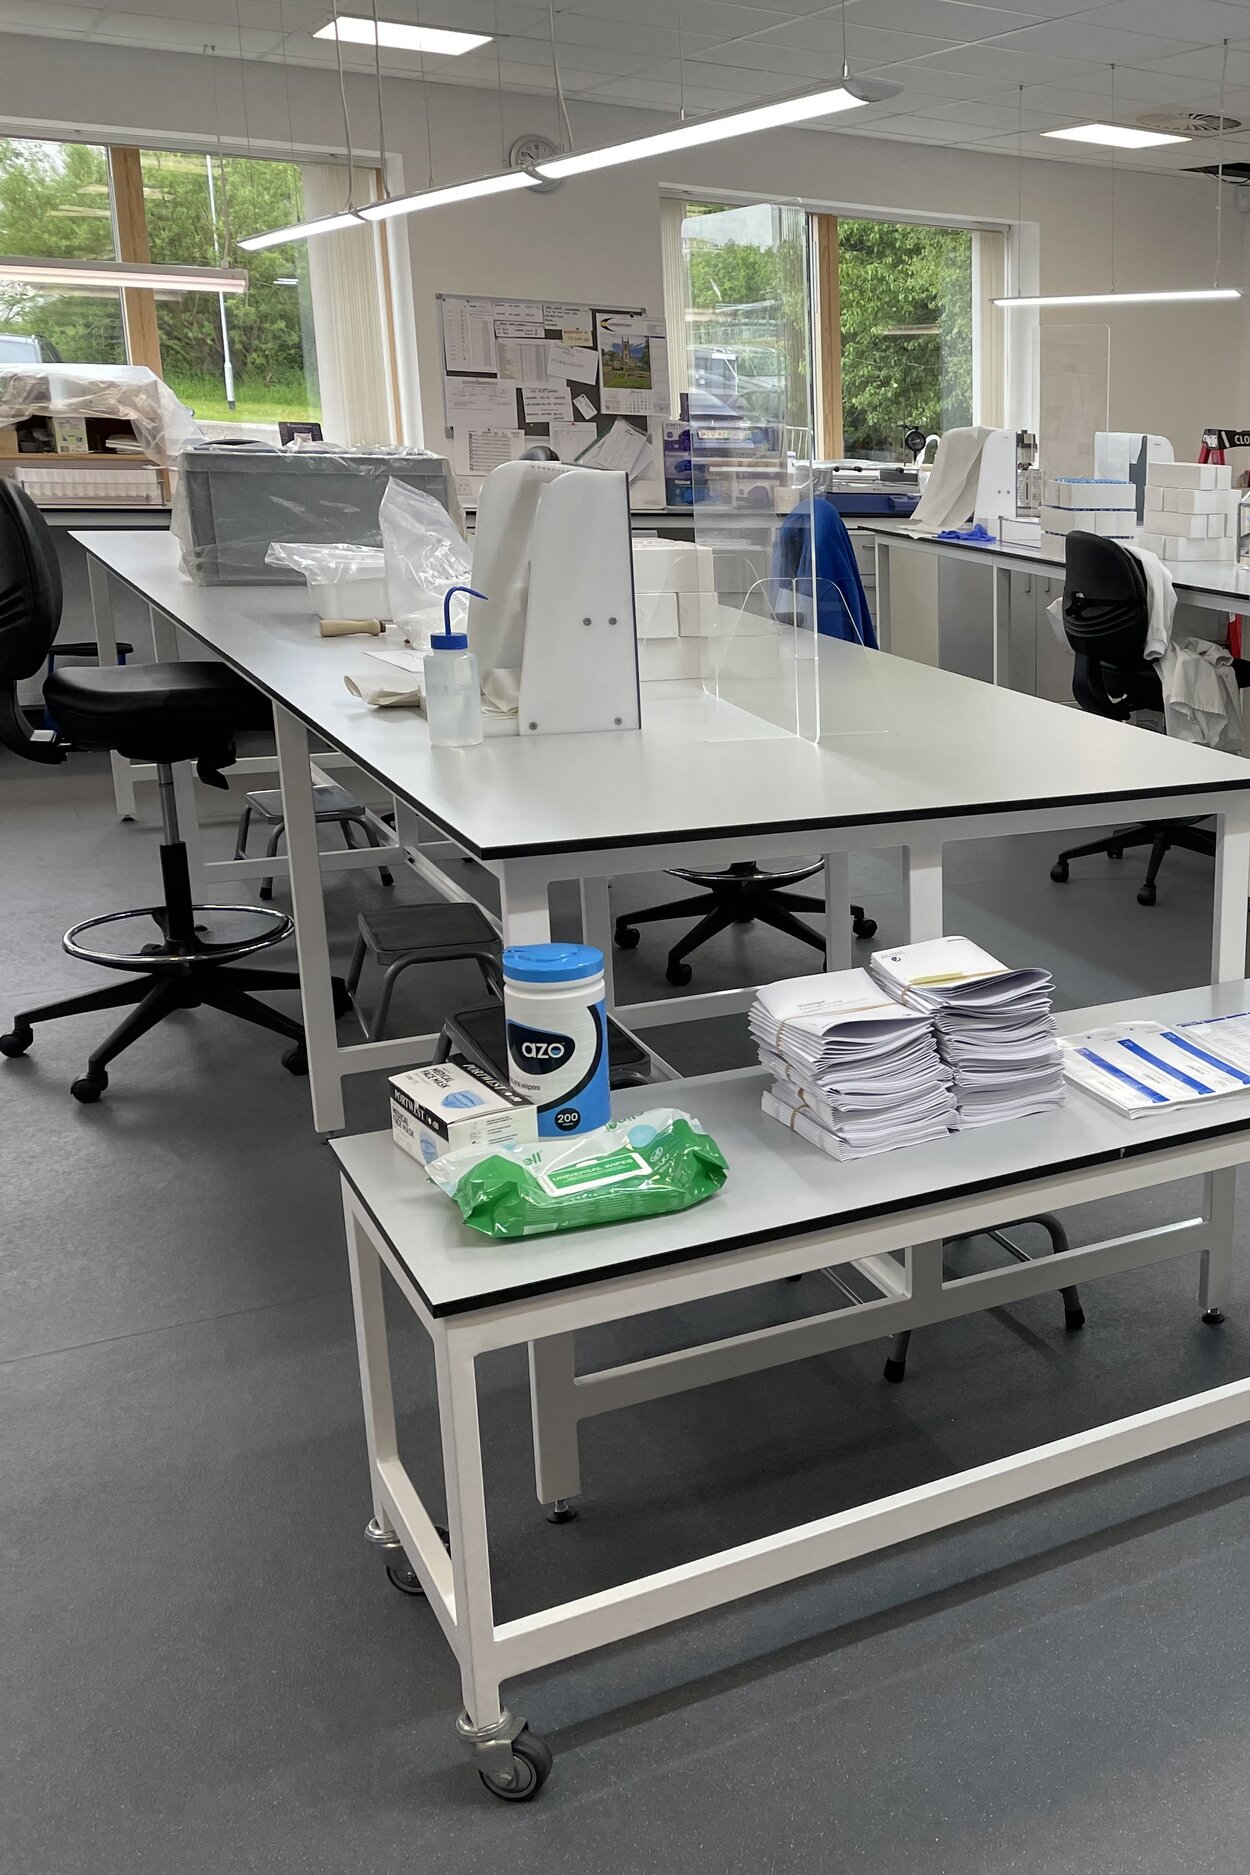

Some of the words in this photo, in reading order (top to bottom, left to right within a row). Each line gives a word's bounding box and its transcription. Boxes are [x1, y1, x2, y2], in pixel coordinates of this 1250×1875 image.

[522, 1042, 564, 1058] azo
[462, 1063, 507, 1091] PORTWEST
[394, 1089, 425, 1121] PORTWEST
[557, 1112, 578, 1123] 200
[552, 1167, 603, 1181] UNIVERSAL
[604, 1158, 633, 1169] WIPES
